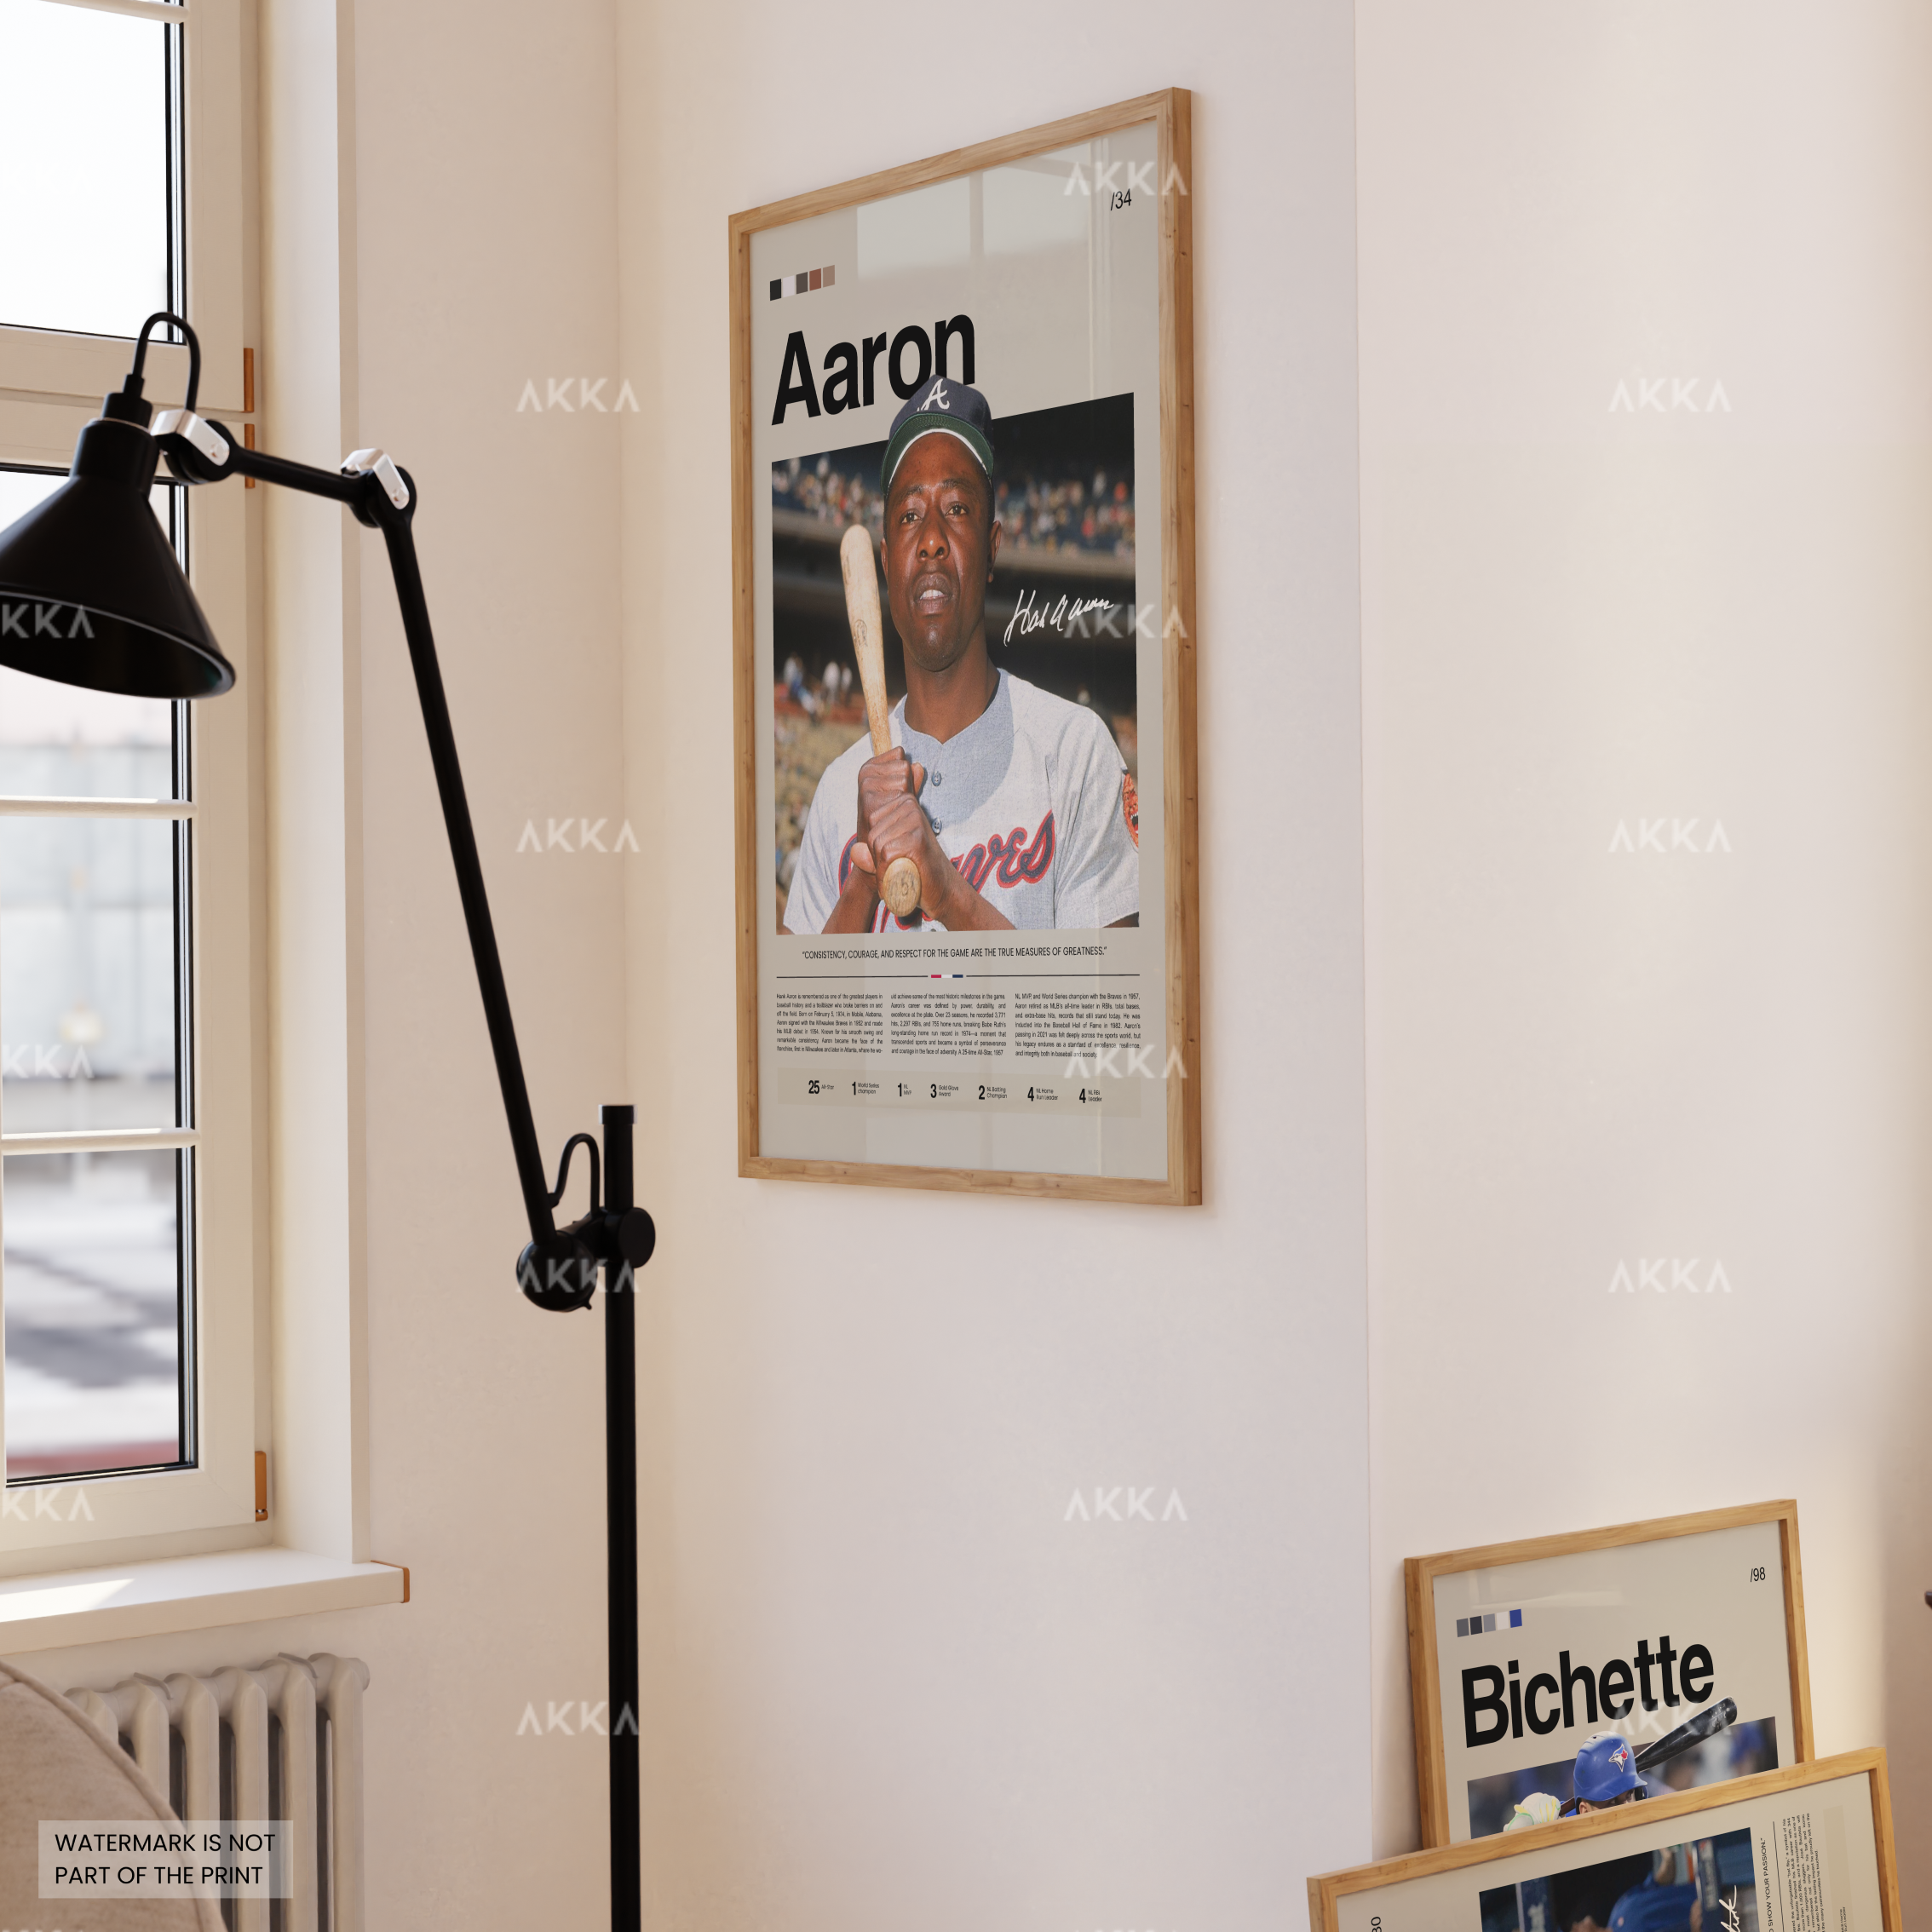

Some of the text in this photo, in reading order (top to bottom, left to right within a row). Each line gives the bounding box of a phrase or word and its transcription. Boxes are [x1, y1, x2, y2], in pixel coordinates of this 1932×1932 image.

[1110, 190, 1132, 211] /34
[771, 313, 975, 426] Aaron
[802, 946, 1107, 960] “CONSISTENCY, COURAGE, AND RESPECT FOR THE GAME ARE THE TRUE MEASURES OF GREATNESS.”
[808, 1080, 819, 1094] 25
[852, 1081, 856, 1095] 1
[898, 1083, 902, 1096] 1
[930, 1084, 937, 1098] 3
[979, 1085, 985, 1100] 2
[1027, 1087, 1034, 1101] 4
[1079, 1089, 1086, 1103] 4
[1749, 1567, 1767, 1584] /98
[1460, 1635, 1715, 1748] Bichette
